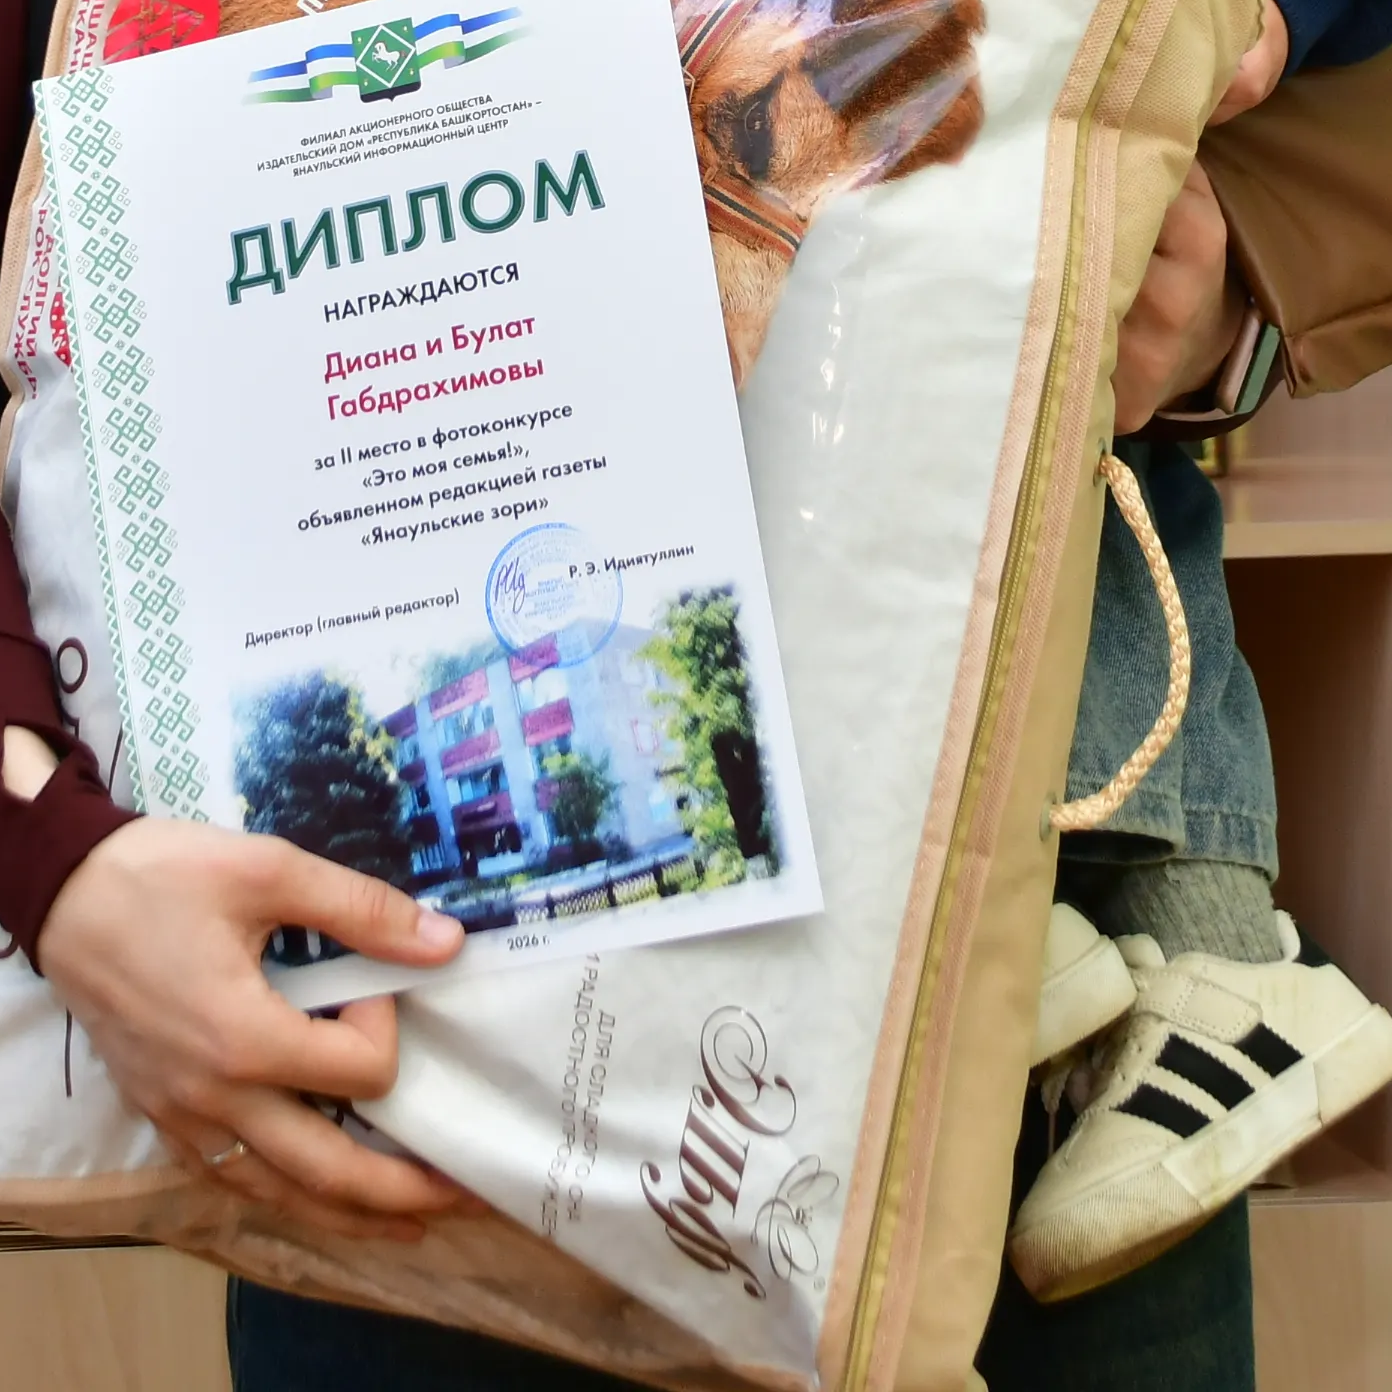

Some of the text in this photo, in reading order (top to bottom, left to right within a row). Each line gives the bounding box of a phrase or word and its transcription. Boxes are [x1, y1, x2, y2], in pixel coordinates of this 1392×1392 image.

[256, 100, 532, 171] ИЗДАТЕЛЬСКИЙ ДОМ «РЕСПУБЛИКА БАШКОРТОСТАН»
[292, 118, 509, 177] ЯНАУЛЬСКИЙ ИНФОРМАЦИОННЫЙ ЦЕНТР
[299, 93, 493, 146] ФИЛИАЛ АКЦИОНЕРНОГО ОБЩЕСТВА
[225, 149, 606, 305] ДИПЛОМ
[26, 234, 55, 357] ДОЛГИЙ
[323, 261, 519, 323] НАГРАЖДАЮТСЯ
[323, 316, 535, 384] Диана и Булат
[327, 358, 544, 420] Габдрахимовы
[313, 455, 335, 470] за
[357, 439, 411, 461] место
[416, 435, 427, 448] в
[431, 404, 572, 449] фотоконкурсе
[362, 440, 529, 488] «Это моя семья!»,
[297, 455, 606, 531] объявленном редакцией газеты
[360, 497, 548, 546] «Янаульские зори»
[568, 544, 694, 579] Р. Э. Идиятуллин
[244, 586, 459, 649] Директор (главный редактор)
[506, 933, 539, 951] 2026
[562, 966, 598, 1115] РАДОСТНОГО
[594, 1010, 615, 1059] ДЛЯ
